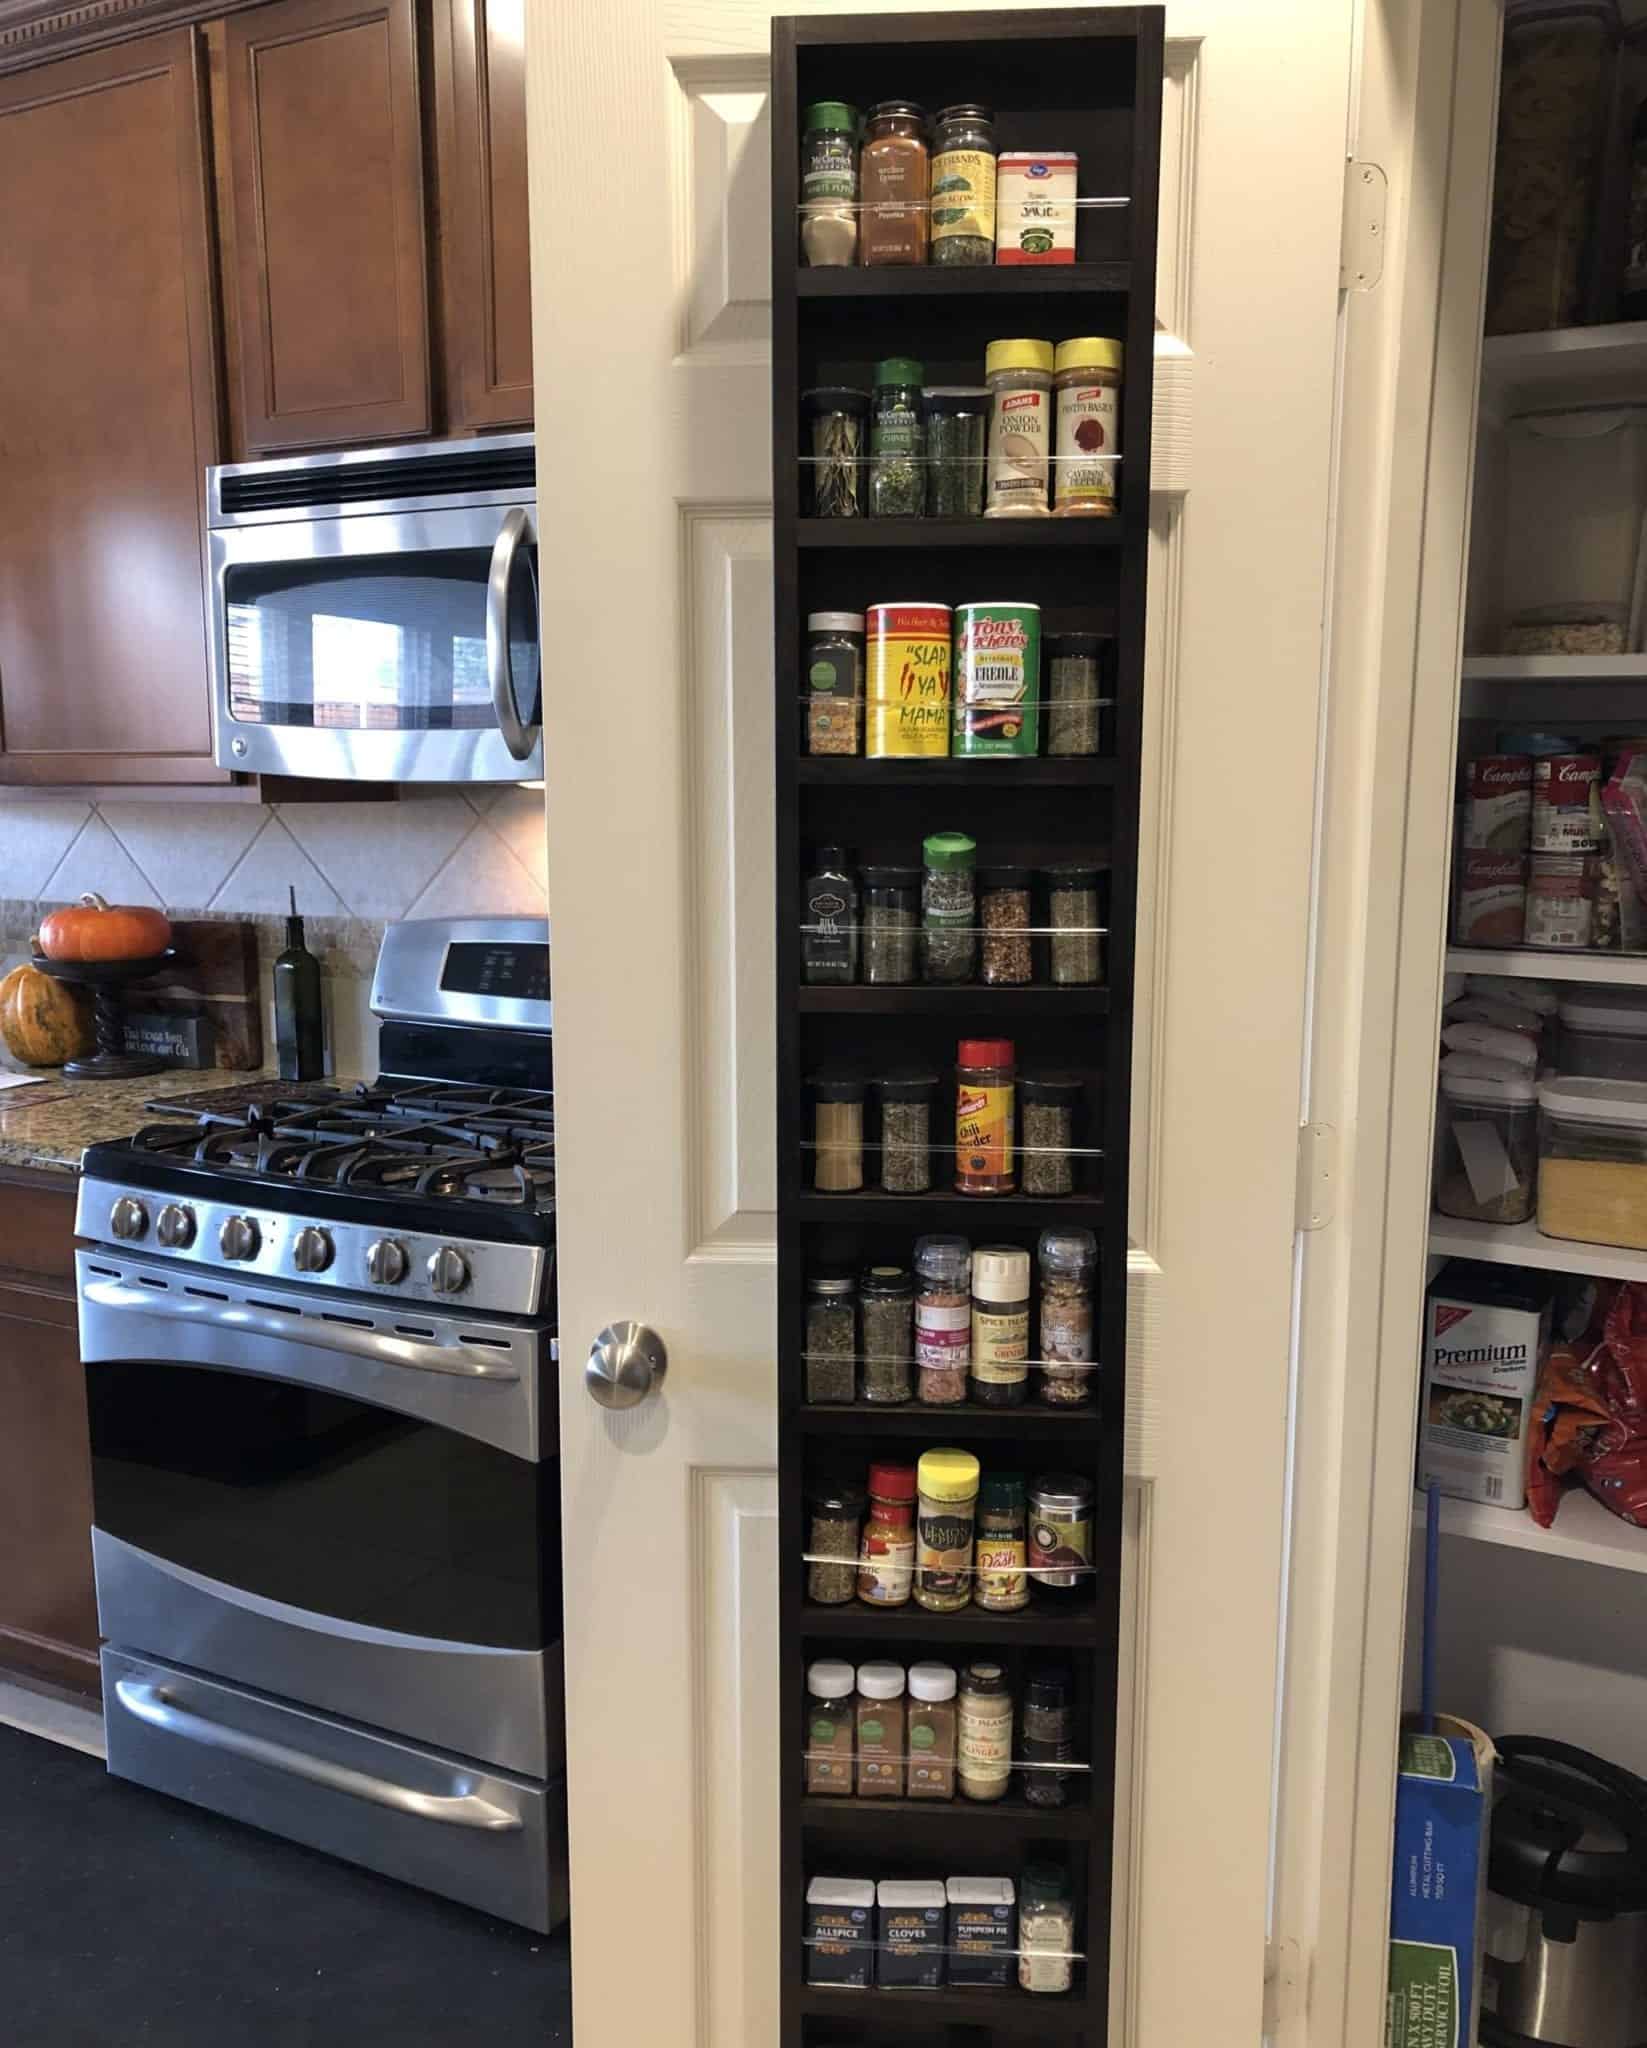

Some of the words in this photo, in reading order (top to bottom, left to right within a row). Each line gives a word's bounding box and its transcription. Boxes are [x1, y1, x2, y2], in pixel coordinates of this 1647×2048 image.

[1002, 415, 1039, 425] ONION
[1000, 424, 1042, 434] POWDER
[975, 667, 1019, 681] CREOLE
[917, 675, 937, 696] YA
[900, 706, 946, 726] MAMA
[1433, 1344, 1527, 1366] Premium
[980, 1551, 1017, 1568] Dash
[816, 1927, 859, 1938] ALLSPICE
[888, 1928, 927, 1938] CLOVES
[957, 1926, 995, 1935] PUMPKIN
[996, 1926, 1008, 1936] PIE
[1438, 1963, 1452, 1994] FOIL
[1410, 1981, 1423, 2000] FT
[1423, 1982, 1437, 2022] DUTY
[1409, 2001, 1422, 2023] 500
[1407, 2024, 1421, 2036] X
